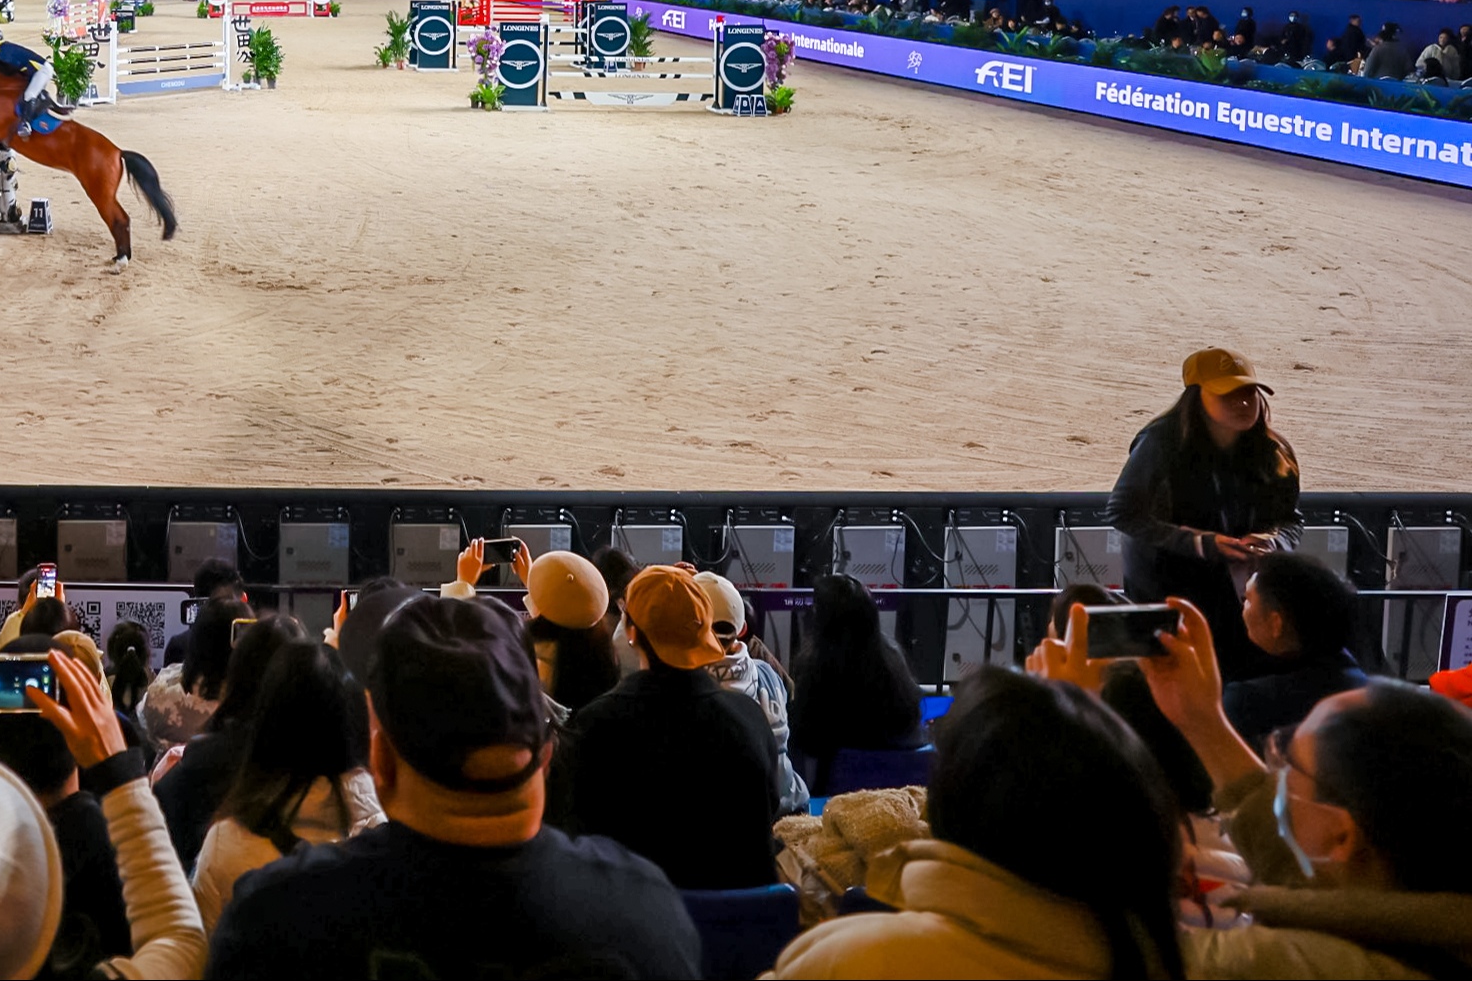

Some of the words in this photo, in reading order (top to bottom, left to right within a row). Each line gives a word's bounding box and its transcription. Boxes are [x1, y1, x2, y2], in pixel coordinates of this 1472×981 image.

[503, 24, 539, 32] LONGINES
[662, 9, 686, 29] FEI
[792, 32, 865, 58] Internationale
[727, 27, 763, 35] LONGINES
[975, 60, 1033, 93] FEI
[1095, 81, 1210, 120] Fédération
[1217, 101, 1332, 141] Equestre
[33, 207, 43, 218] 11
